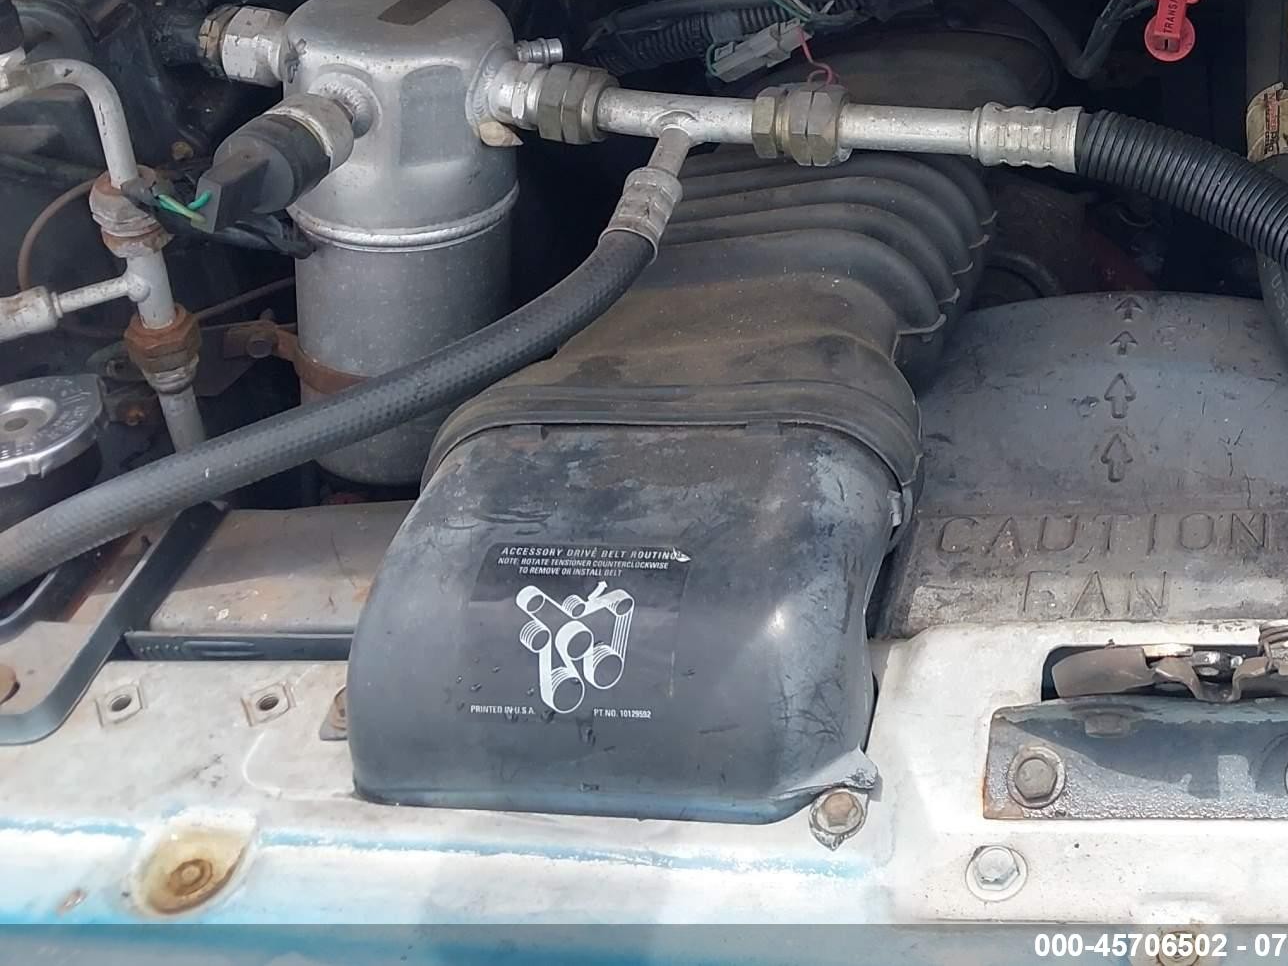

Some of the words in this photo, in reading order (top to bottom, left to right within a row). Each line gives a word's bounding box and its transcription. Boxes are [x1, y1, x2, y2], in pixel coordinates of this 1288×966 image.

[937, 512, 1270, 556] CAUTION
[501, 546, 563, 557] ACCESSORY
[566, 548, 598, 558] DRIVE
[600, 549, 627, 559] BELT
[520, 557, 550, 567] ROTATE
[550, 558, 592, 568] TENSIONER
[592, 560, 670, 570] COUNTERCLOCKWISE
[518, 566, 529, 575] TO
[529, 566, 561, 576] REMOVE
[560, 567, 572, 576] OR
[572, 568, 603, 577] INSTALL
[603, 569, 623, 577] BELT
[1023, 569, 1172, 618] FAN
[470, 705, 503, 715] PRINTED
